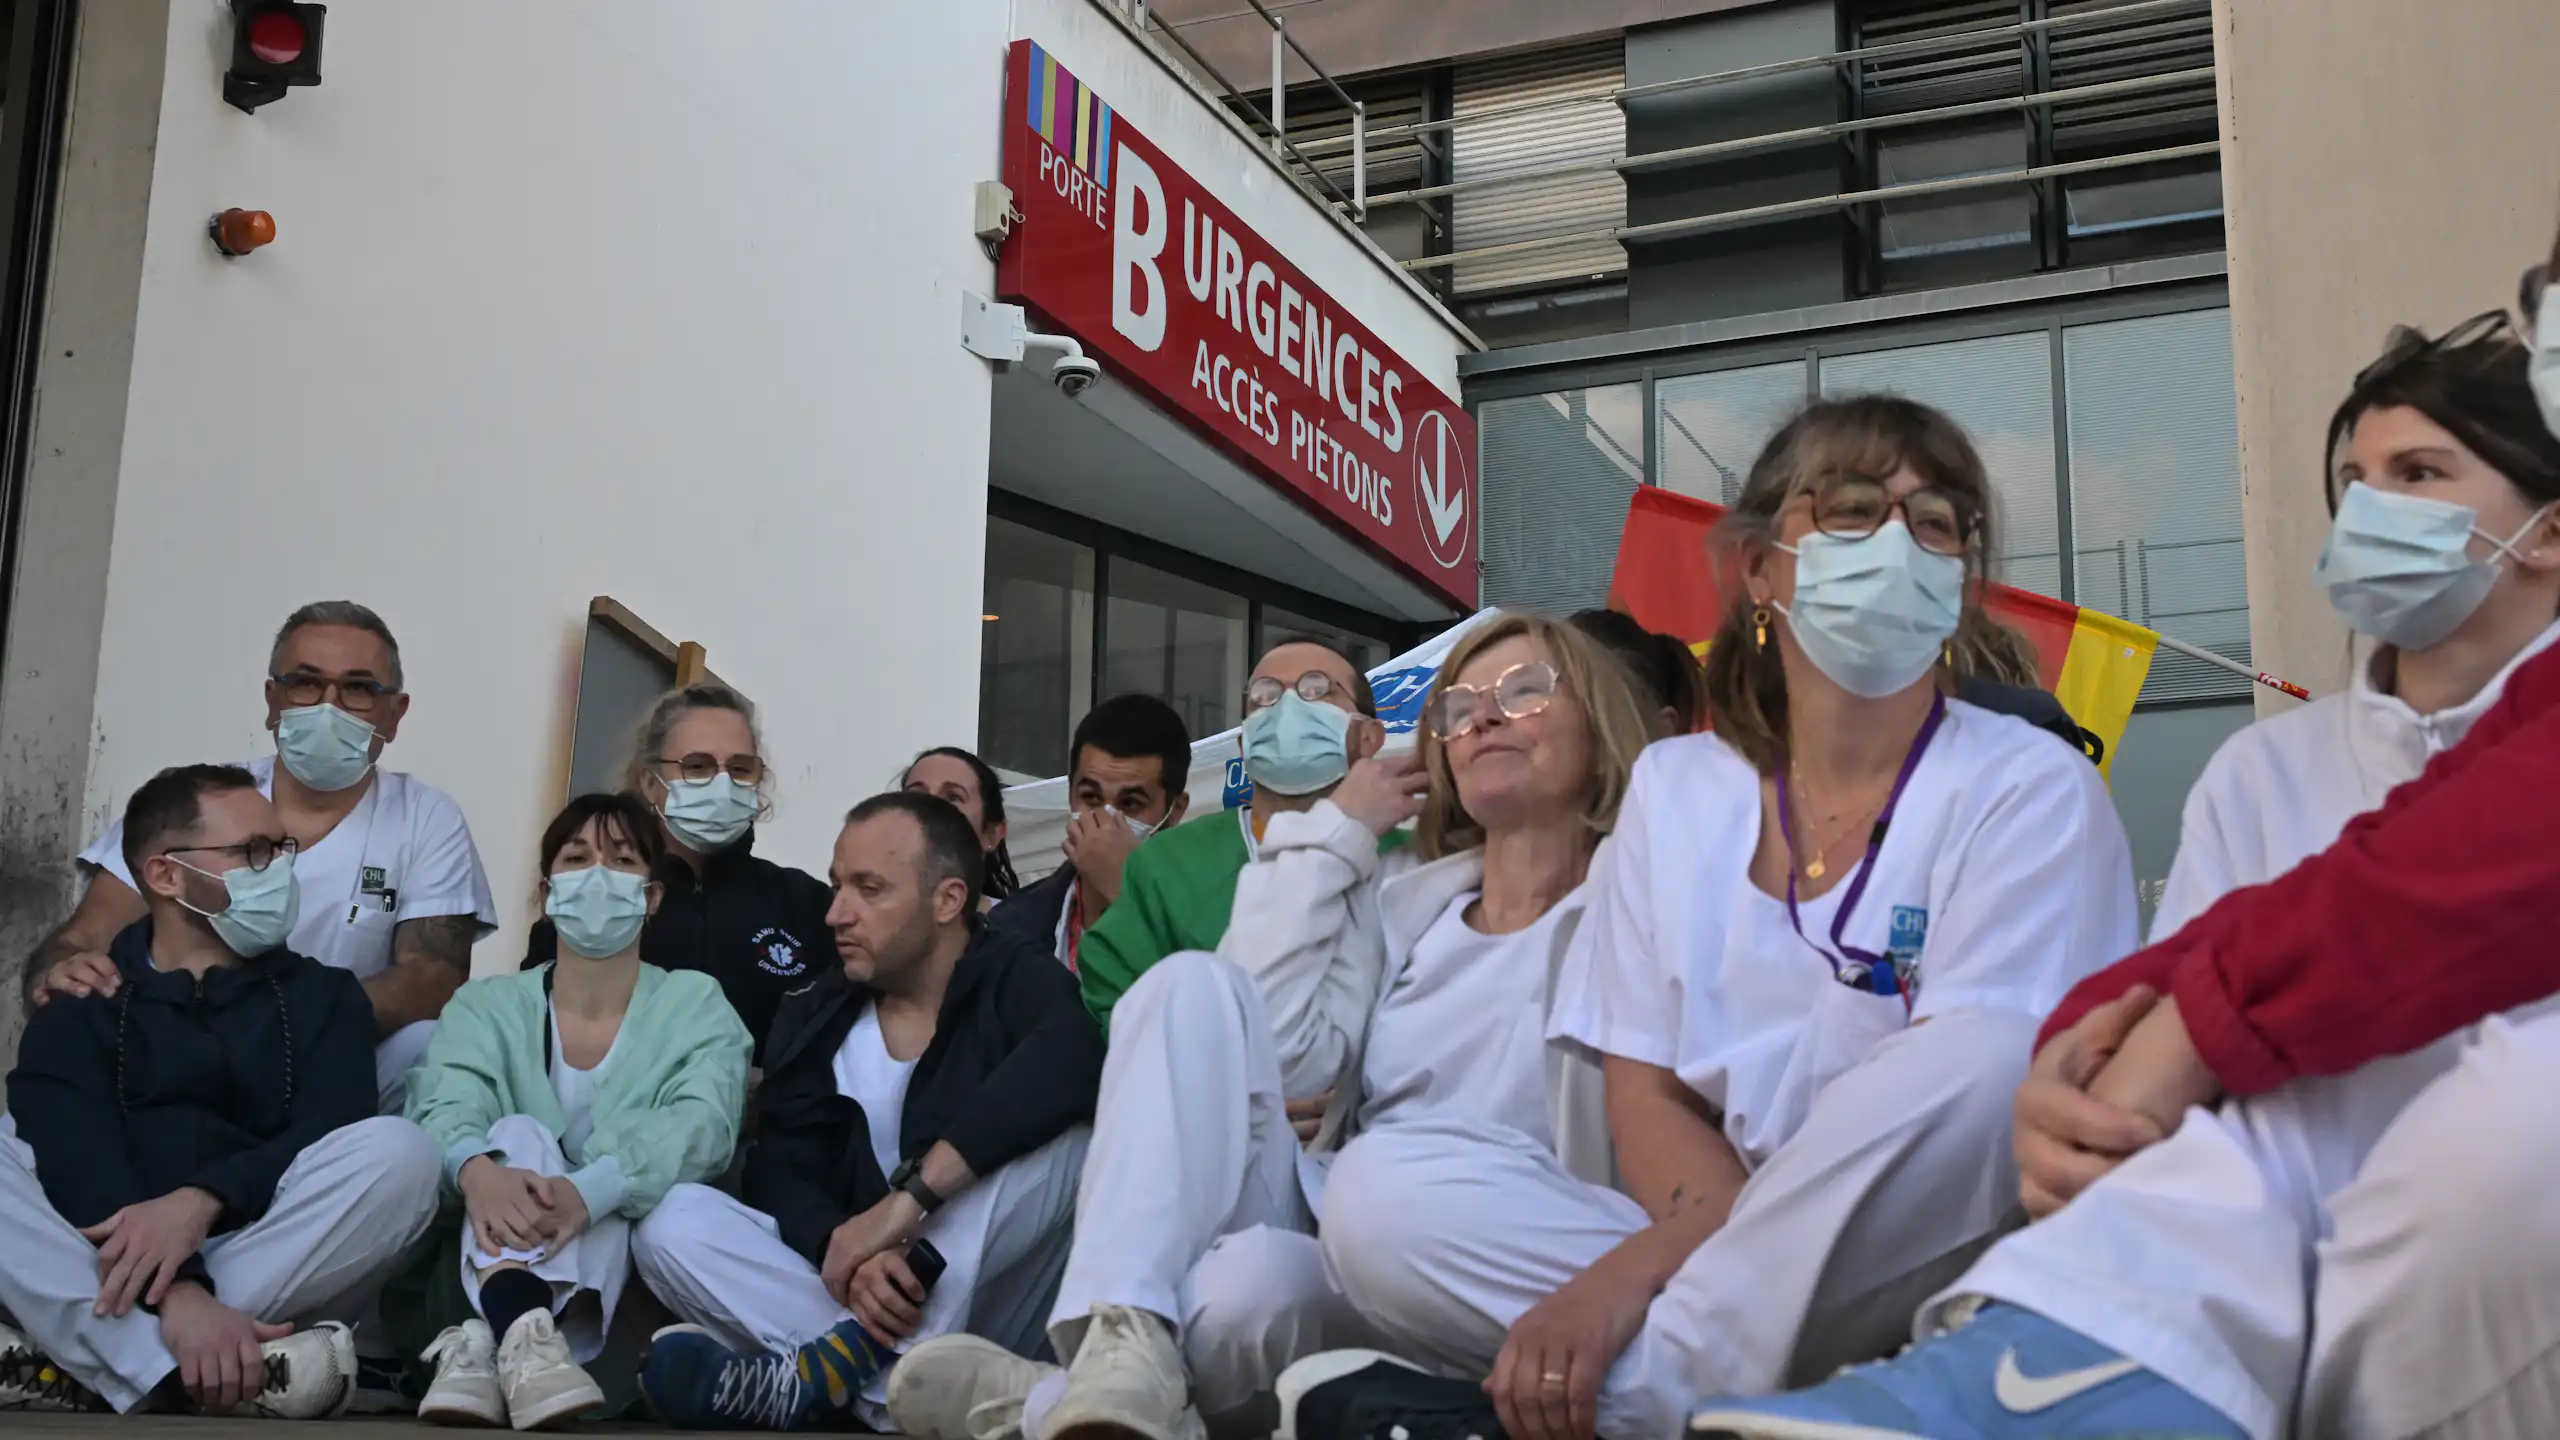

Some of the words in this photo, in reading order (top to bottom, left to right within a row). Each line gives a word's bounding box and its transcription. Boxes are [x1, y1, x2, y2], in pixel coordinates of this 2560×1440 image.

[1039, 142, 1108, 231] PORTE
[1112, 140, 1168, 353] B
[1183, 197, 1404, 453] URGENCES
[1191, 338, 1280, 446] ACCÈS
[1291, 409, 1393, 527] PIÉTONS
[363, 868, 385, 882] CHU
[751, 927, 775, 944] SAMU
[757, 959, 806, 976] URGENCES
